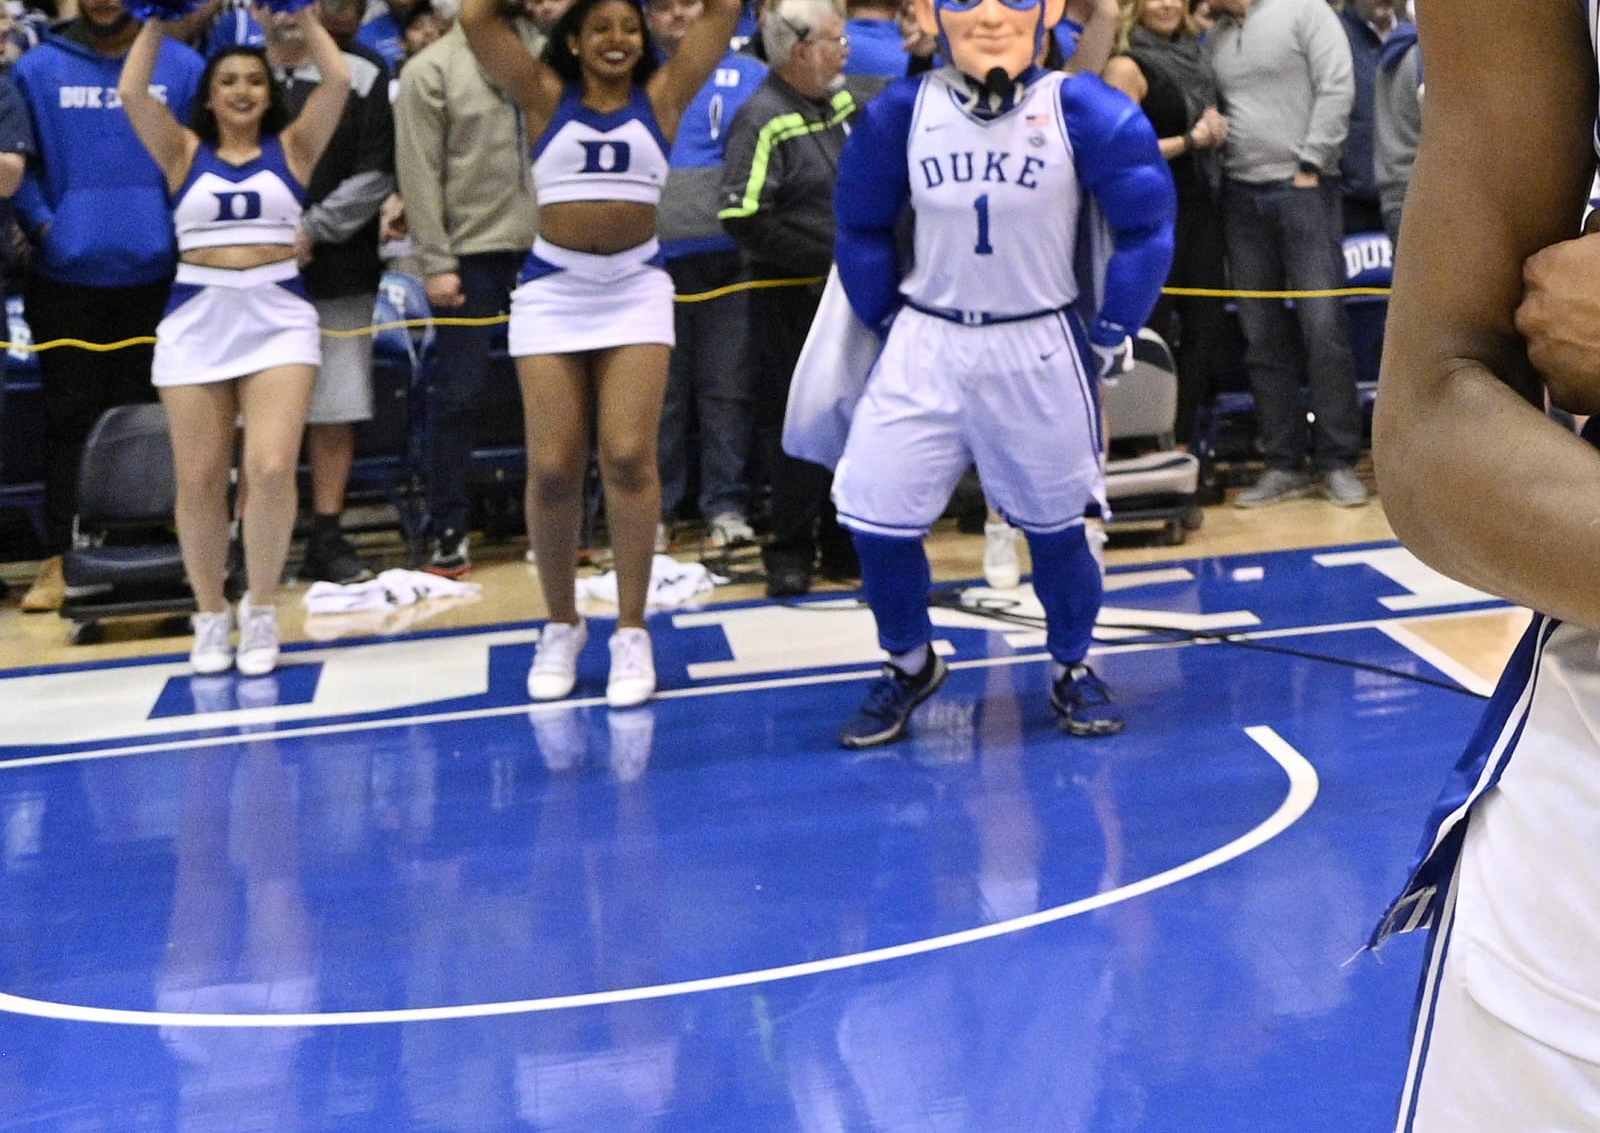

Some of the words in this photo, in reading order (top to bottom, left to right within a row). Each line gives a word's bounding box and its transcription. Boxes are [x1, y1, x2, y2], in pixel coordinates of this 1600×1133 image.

[576, 141, 630, 174] D
[920, 151, 1045, 190] DUKE
[211, 191, 261, 221] D
[974, 193, 994, 255] 1
